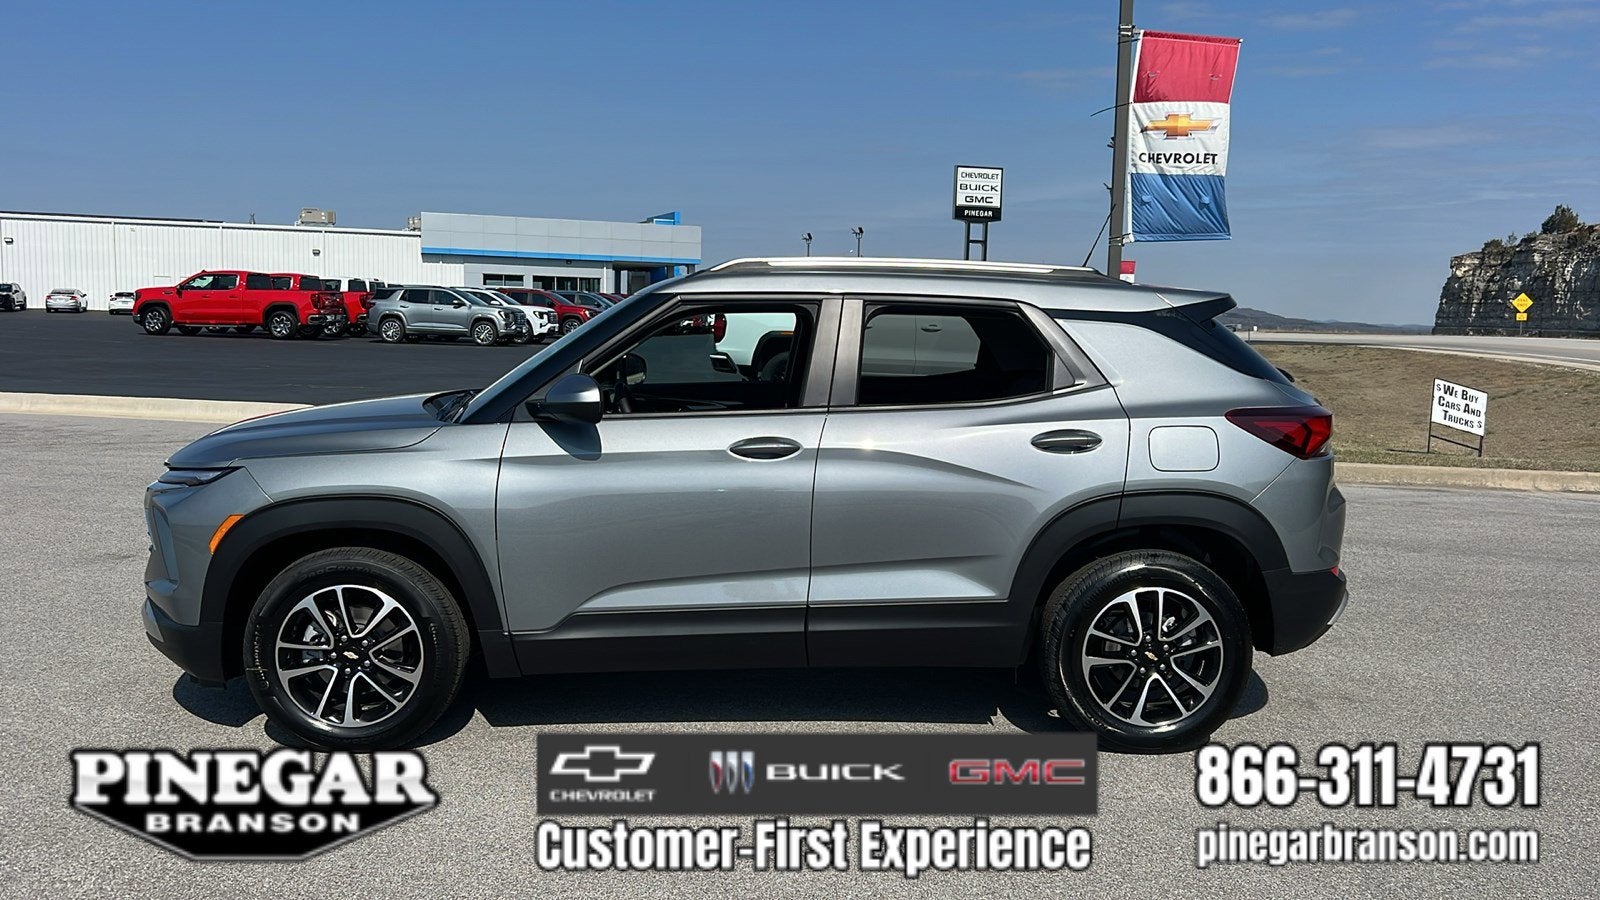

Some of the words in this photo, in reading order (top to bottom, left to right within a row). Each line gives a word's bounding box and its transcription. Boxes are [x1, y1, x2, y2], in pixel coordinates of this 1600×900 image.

[1138, 152, 1218, 165] CHEVROLET
[961, 172, 999, 180] CHEVROLET
[960, 183, 999, 192] BUICK
[964, 196, 993, 204] GMC
[964, 209, 993, 217] PINEGAR
